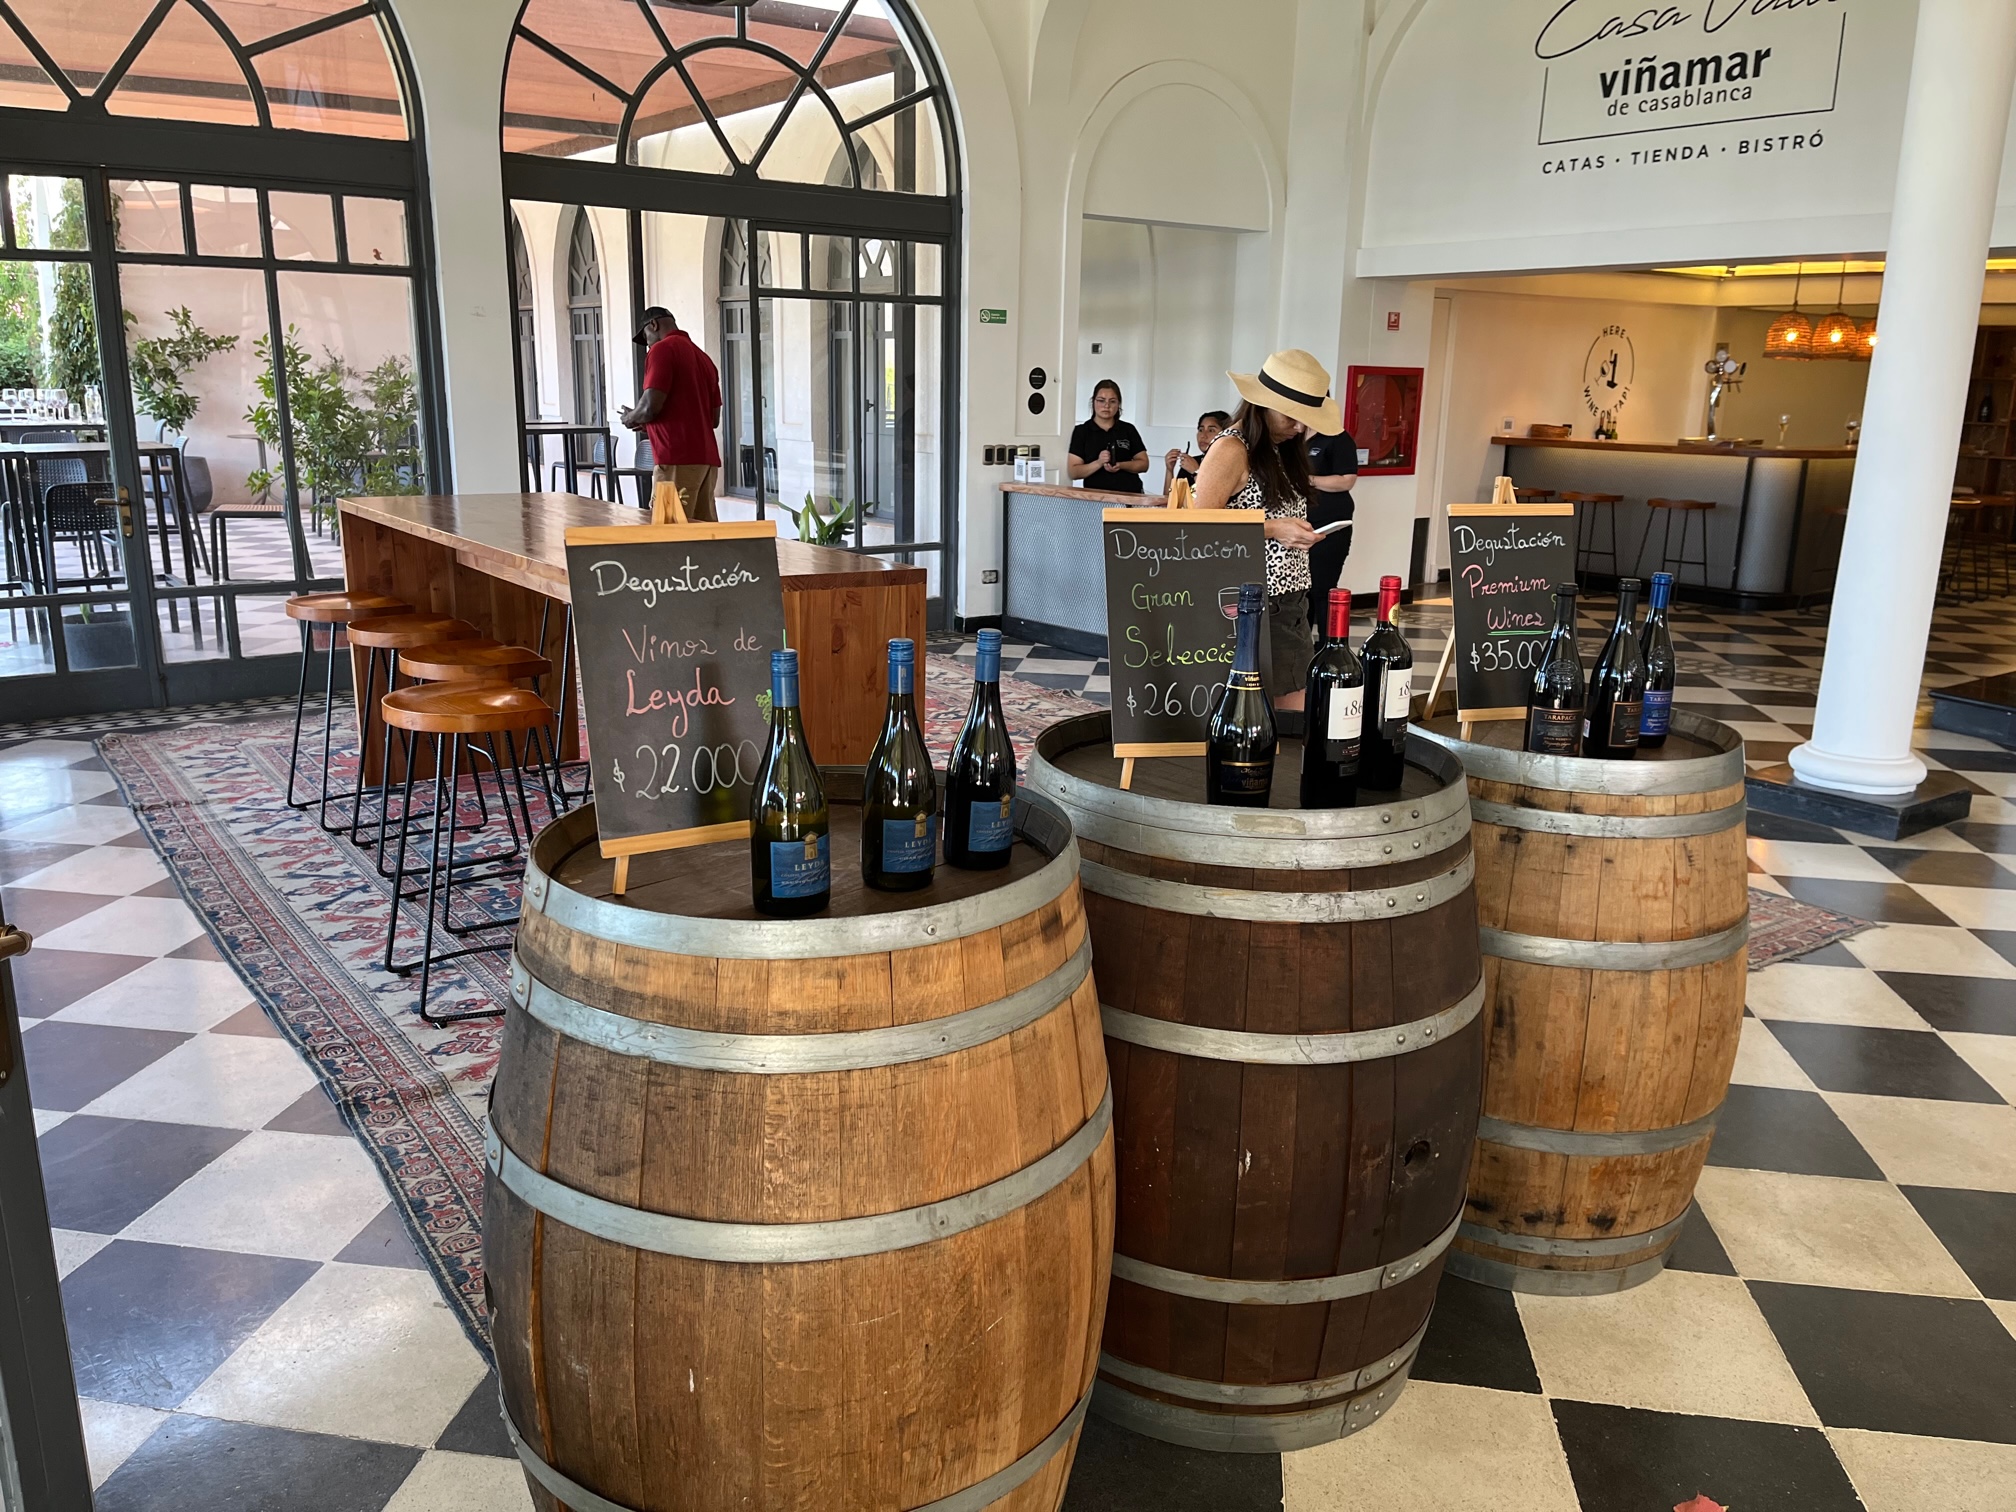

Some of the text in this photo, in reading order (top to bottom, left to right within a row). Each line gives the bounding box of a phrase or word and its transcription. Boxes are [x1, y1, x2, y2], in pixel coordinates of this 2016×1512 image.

[1600, 48, 1771, 98] viñamar
[1607, 85, 1752, 116] de casablanca
[1542, 129, 1824, 174] CATAS TIENDA BISTRÓ
[1602, 325, 1626, 339] HERE
[1583, 385, 1599, 417] WINE
[1613, 386, 1630, 413] TAP!
[1109, 529, 1251, 577] Degustación
[1454, 523, 1567, 566] Degustación
[590, 556, 760, 608] Degustación
[1131, 583, 1194, 612] Gran
[1461, 564, 1550, 598] Premium
[1487, 606, 1545, 630] Wines
[622, 625, 762, 663] Vinos de
[1123, 622, 1237, 668] Selecció
[1470, 639, 1549, 672] $35.00
[625, 667, 735, 738] Leyda
[1126, 682, 1226, 717] $26.00
[1398, 681, 1411, 697] 18
[1344, 700, 1362, 716] 186
[794, 859, 825, 871] LEYDA
